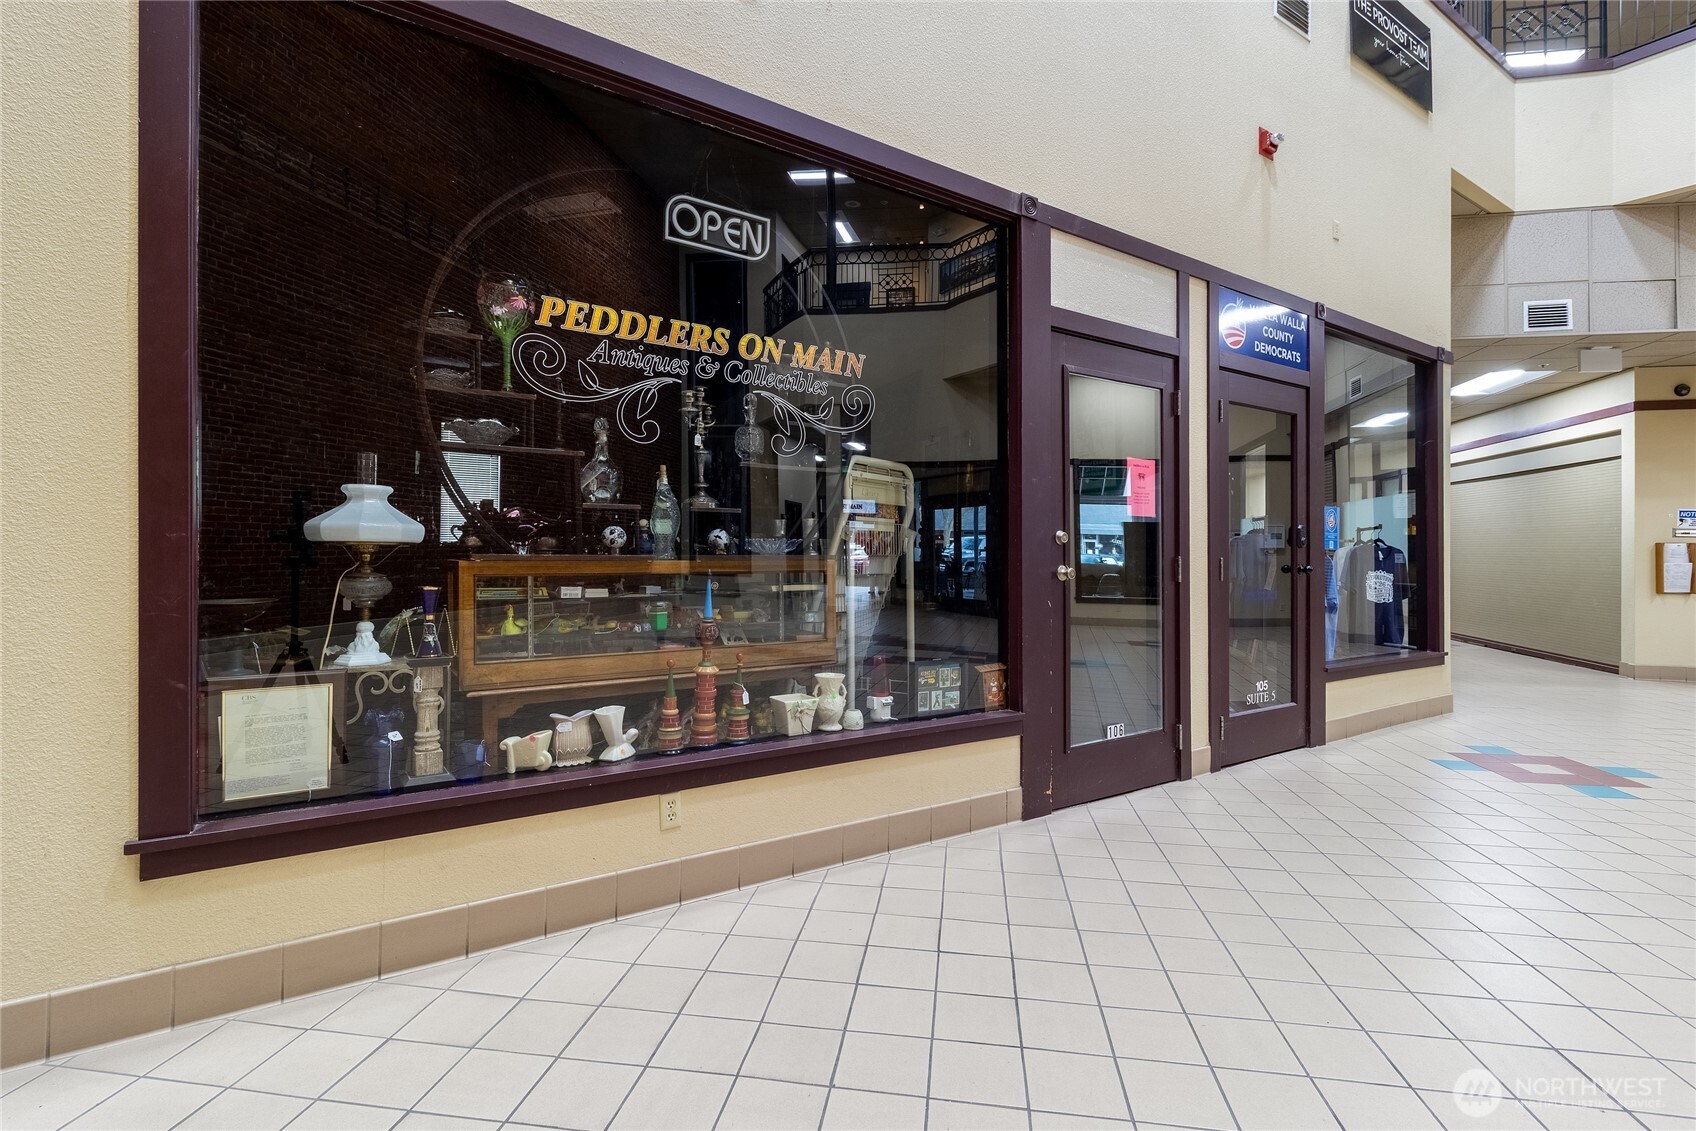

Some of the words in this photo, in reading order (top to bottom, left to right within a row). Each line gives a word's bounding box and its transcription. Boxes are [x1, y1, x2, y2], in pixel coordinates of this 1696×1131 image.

[1372, 6, 1408, 46] PROVOST
[1408, 36, 1428, 63] TEAM
[672, 203, 763, 255] OPEN
[1279, 313, 1306, 332] WALLA
[534, 294, 731, 356] PEDDLERS
[737, 332, 787, 365] ON
[790, 341, 867, 379] MAIN
[1262, 325, 1294, 344] COUNTY
[1254, 340, 1301, 363] DEMOCRATS
[586, 339, 690, 376] Antiques
[694, 355, 721, 380] &
[723, 360, 829, 396] Collectibles
[1255, 680, 1269, 691] 105
[1246, 691, 1270, 705] SUITE
[1271, 690, 1276, 701] 5
[1108, 724, 1124, 738] 106
